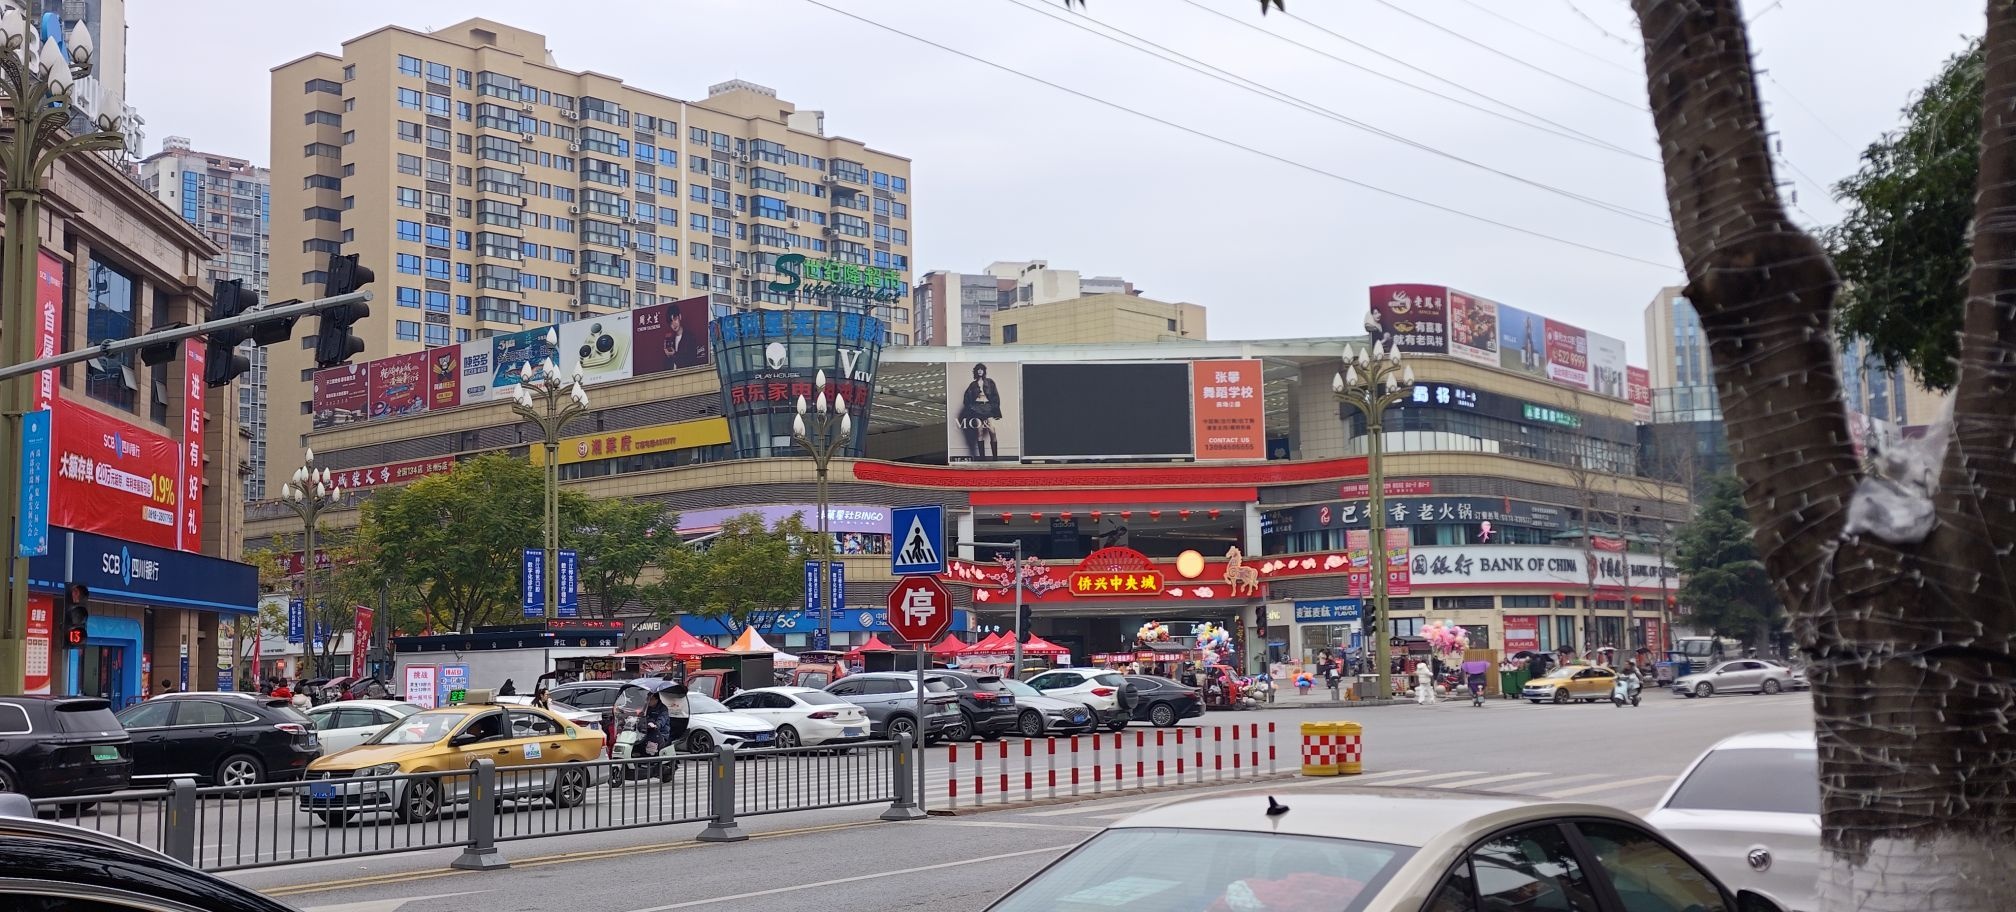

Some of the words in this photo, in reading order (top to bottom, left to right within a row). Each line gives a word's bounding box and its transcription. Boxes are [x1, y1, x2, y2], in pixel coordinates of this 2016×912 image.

[804, 259, 901, 288] 世纪隆超市
[1416, 321, 1443, 333] 有喜事
[1393, 334, 1444, 347] 就有老凤祥
[854, 371, 872, 382] KTV
[1203, 386, 1254, 399] 舞蹈学校
[103, 434, 115, 449] SCB
[121, 441, 140, 458] 四川银行
[188, 372, 200, 534] 进店有好礼
[59, 451, 94, 484] 大额存单
[151, 472, 175, 506] 1.9%
[102, 552, 120, 575] SCB
[131, 558, 159, 581] 四川银行
[1480, 558, 1524, 571] BANK
[1528, 558, 1544, 571] OF
[1547, 559, 1577, 572] CHINA
[1077, 575, 1157, 592] 侨兴中央城
[901, 587, 936, 626] 停
[413, 671, 428, 679] 挑战
[451, 691, 465, 700] 空车
